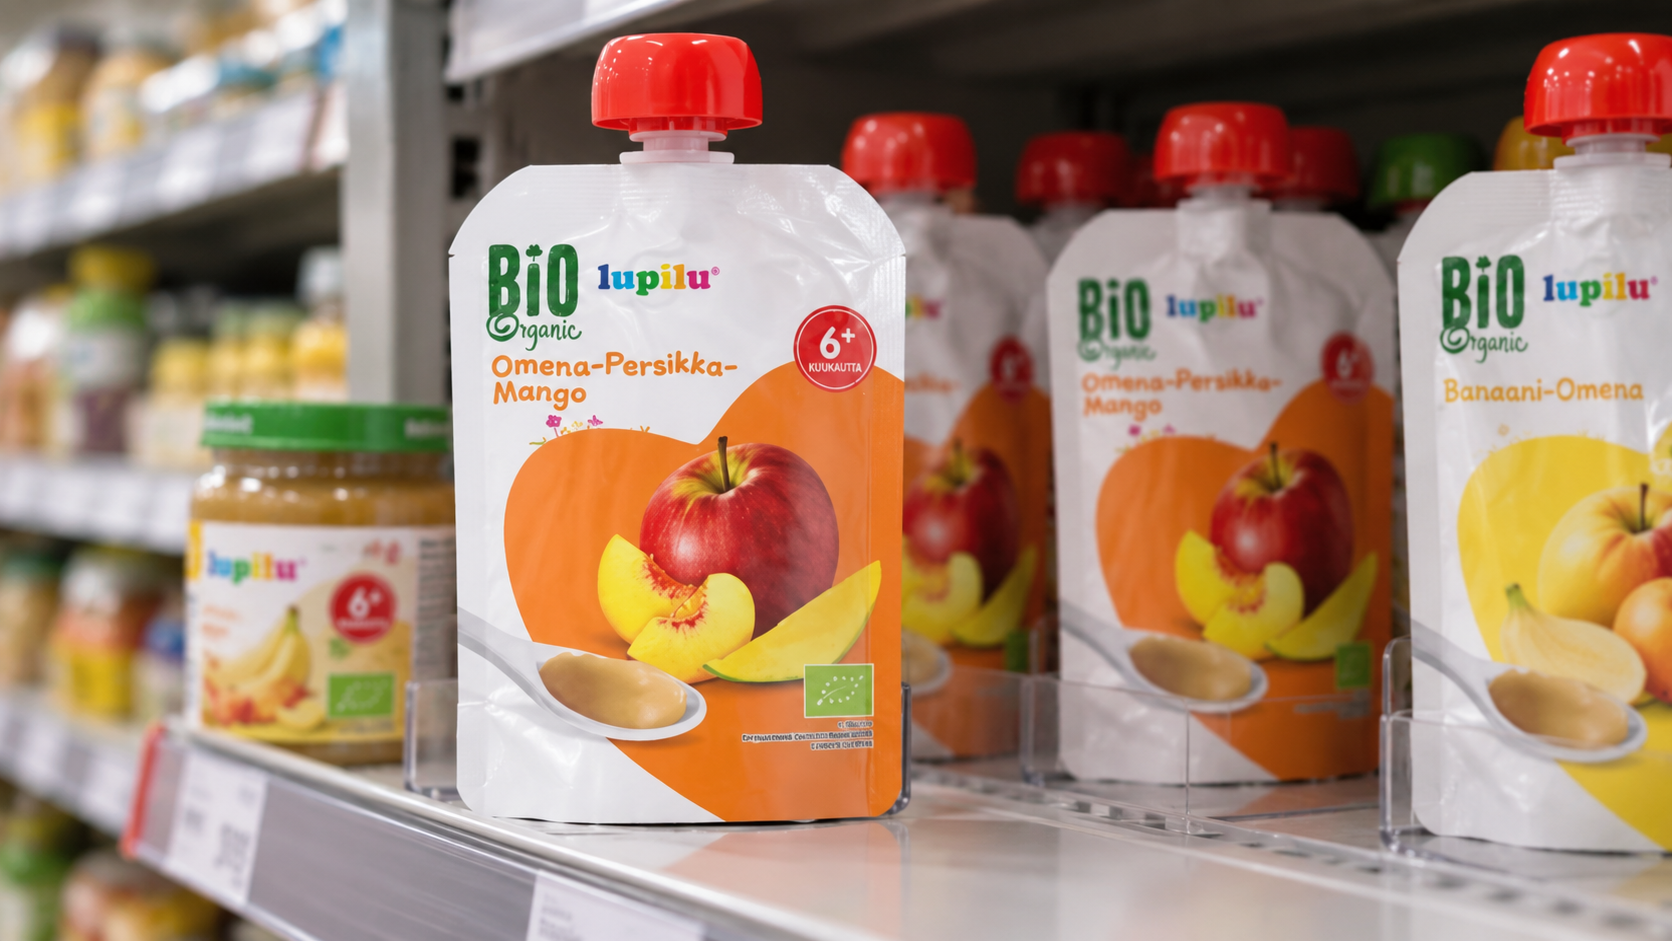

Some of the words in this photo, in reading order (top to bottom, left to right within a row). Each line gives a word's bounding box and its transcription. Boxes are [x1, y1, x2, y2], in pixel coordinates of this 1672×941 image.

[486, 312, 583, 351] Organic
[819, 326, 856, 360] 6+
[1440, 326, 1529, 364] Organic
[491, 351, 738, 378] Omena-Persikka-
[808, 362, 863, 374] KUUKAUTTA
[493, 381, 587, 410] Mango
[1443, 376, 1644, 402] Banaani-Omena
[1083, 396, 1163, 422] Mango
